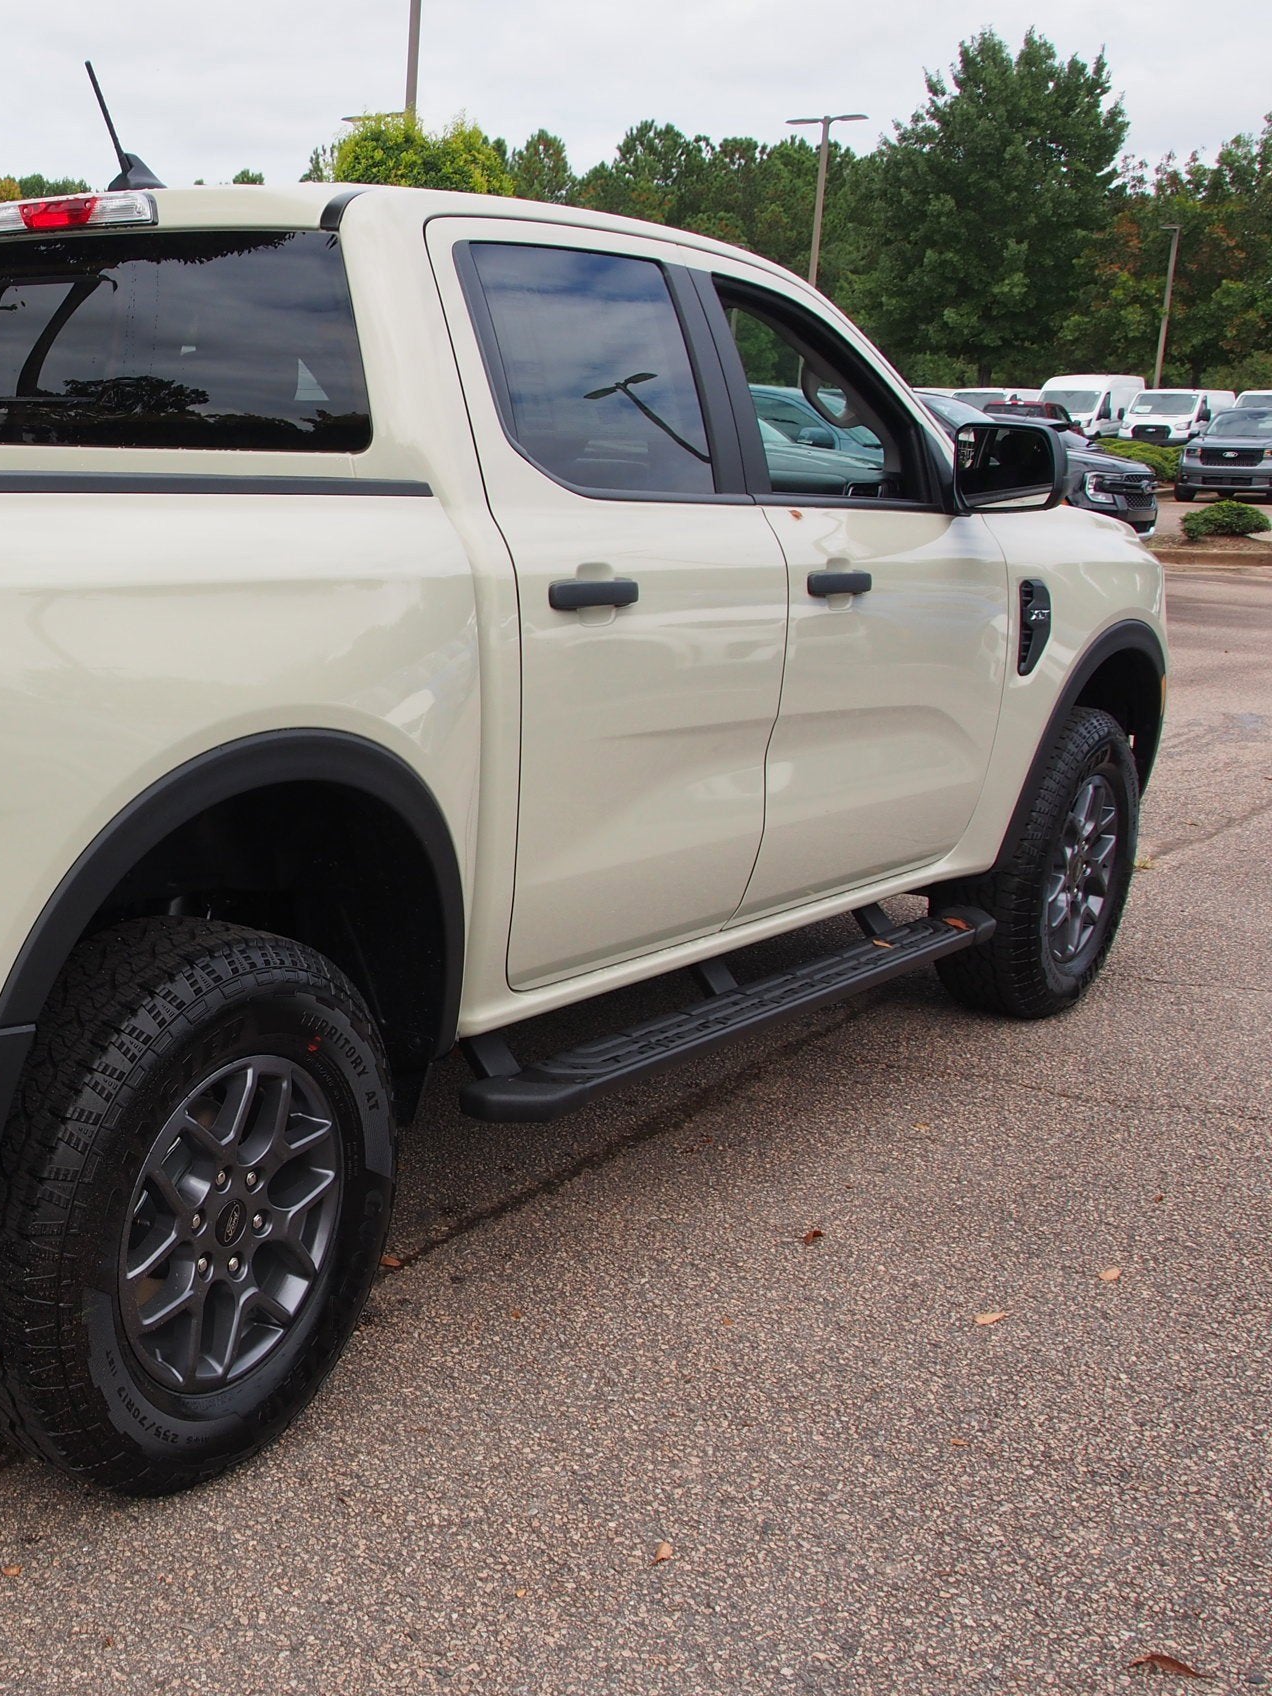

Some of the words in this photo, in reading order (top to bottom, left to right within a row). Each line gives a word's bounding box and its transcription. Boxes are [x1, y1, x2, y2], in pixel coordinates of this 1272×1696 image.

[1030, 609, 1050, 620] XLT
[300, 1009, 370, 1078] TERRITORY
[364, 1090, 380, 1111] AT
[116, 1385, 179, 1444] 255/70R17
